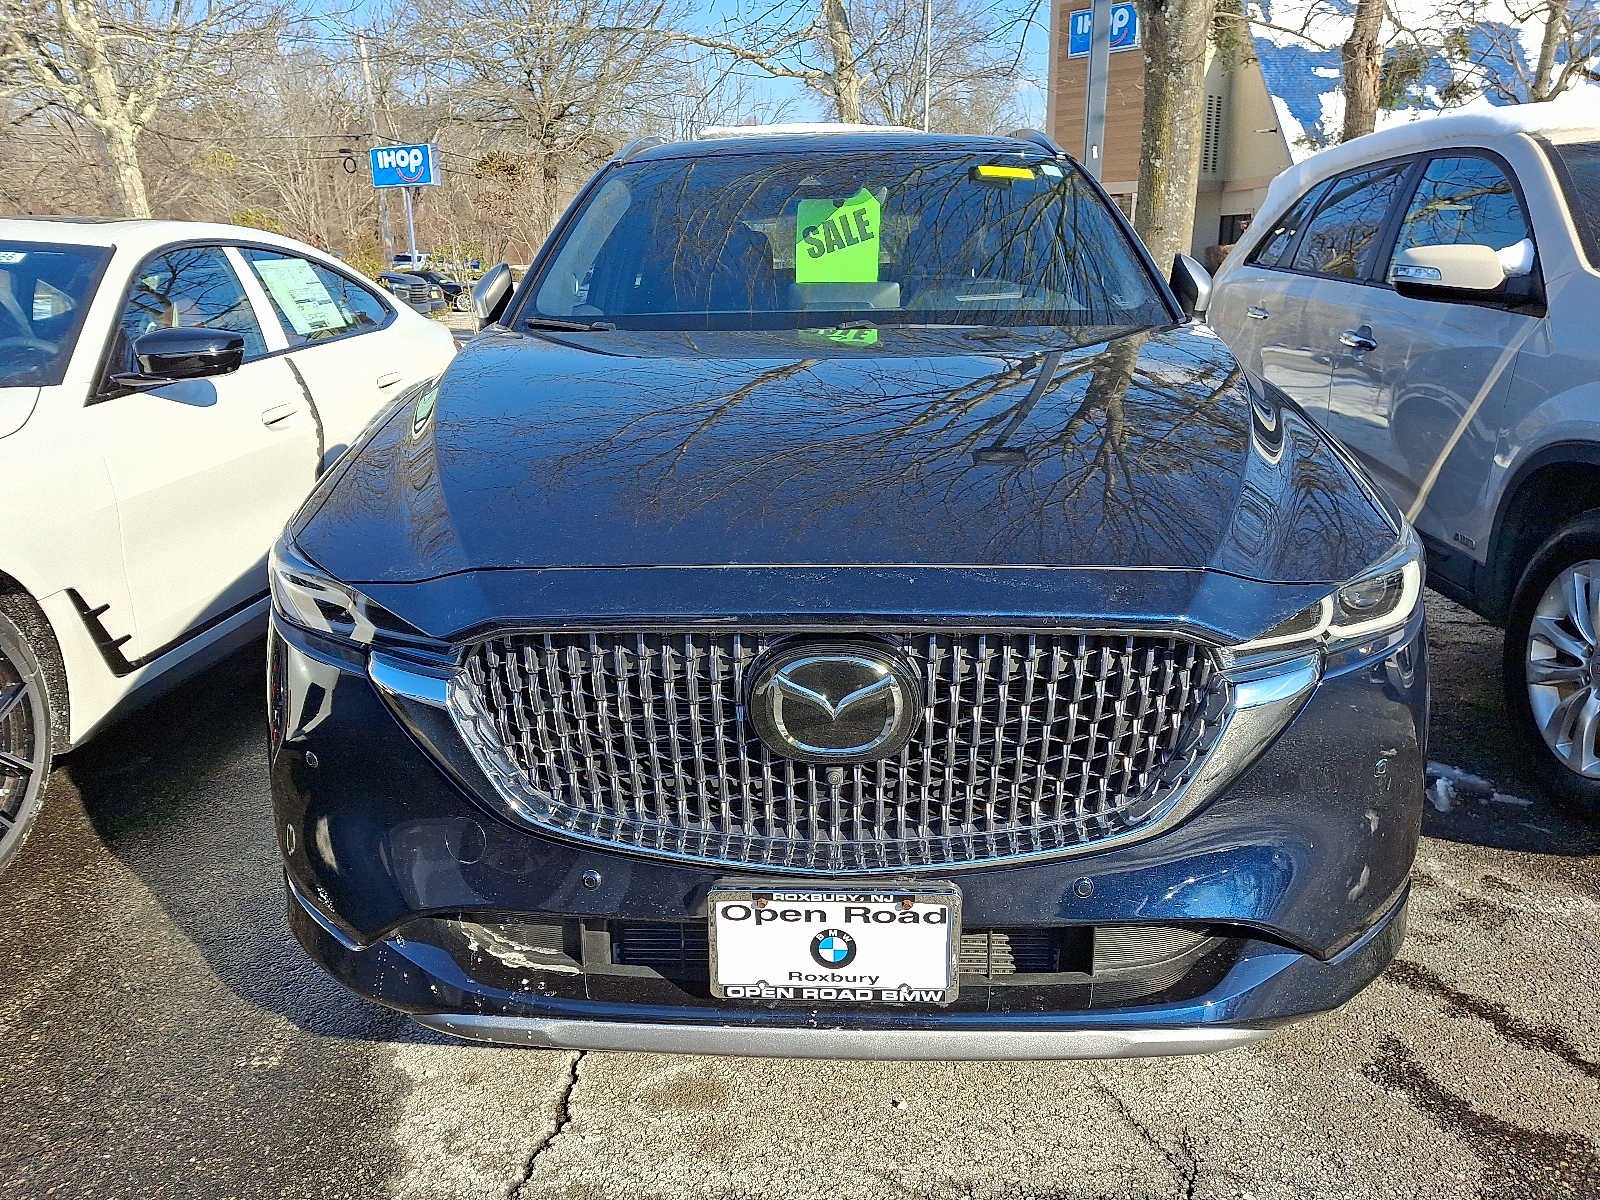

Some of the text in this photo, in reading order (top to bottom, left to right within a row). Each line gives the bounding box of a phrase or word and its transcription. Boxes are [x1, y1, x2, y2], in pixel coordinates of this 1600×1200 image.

[377, 148, 424, 173] IHOP
[802, 207, 875, 259] SALE
[772, 893, 895, 903] ROXBURY, NJ
[720, 904, 947, 926] Open Road
[815, 929, 853, 943] BMW
[788, 971, 880, 986] Roxbury
[726, 986, 944, 1002] OPEN ROAD BMW
